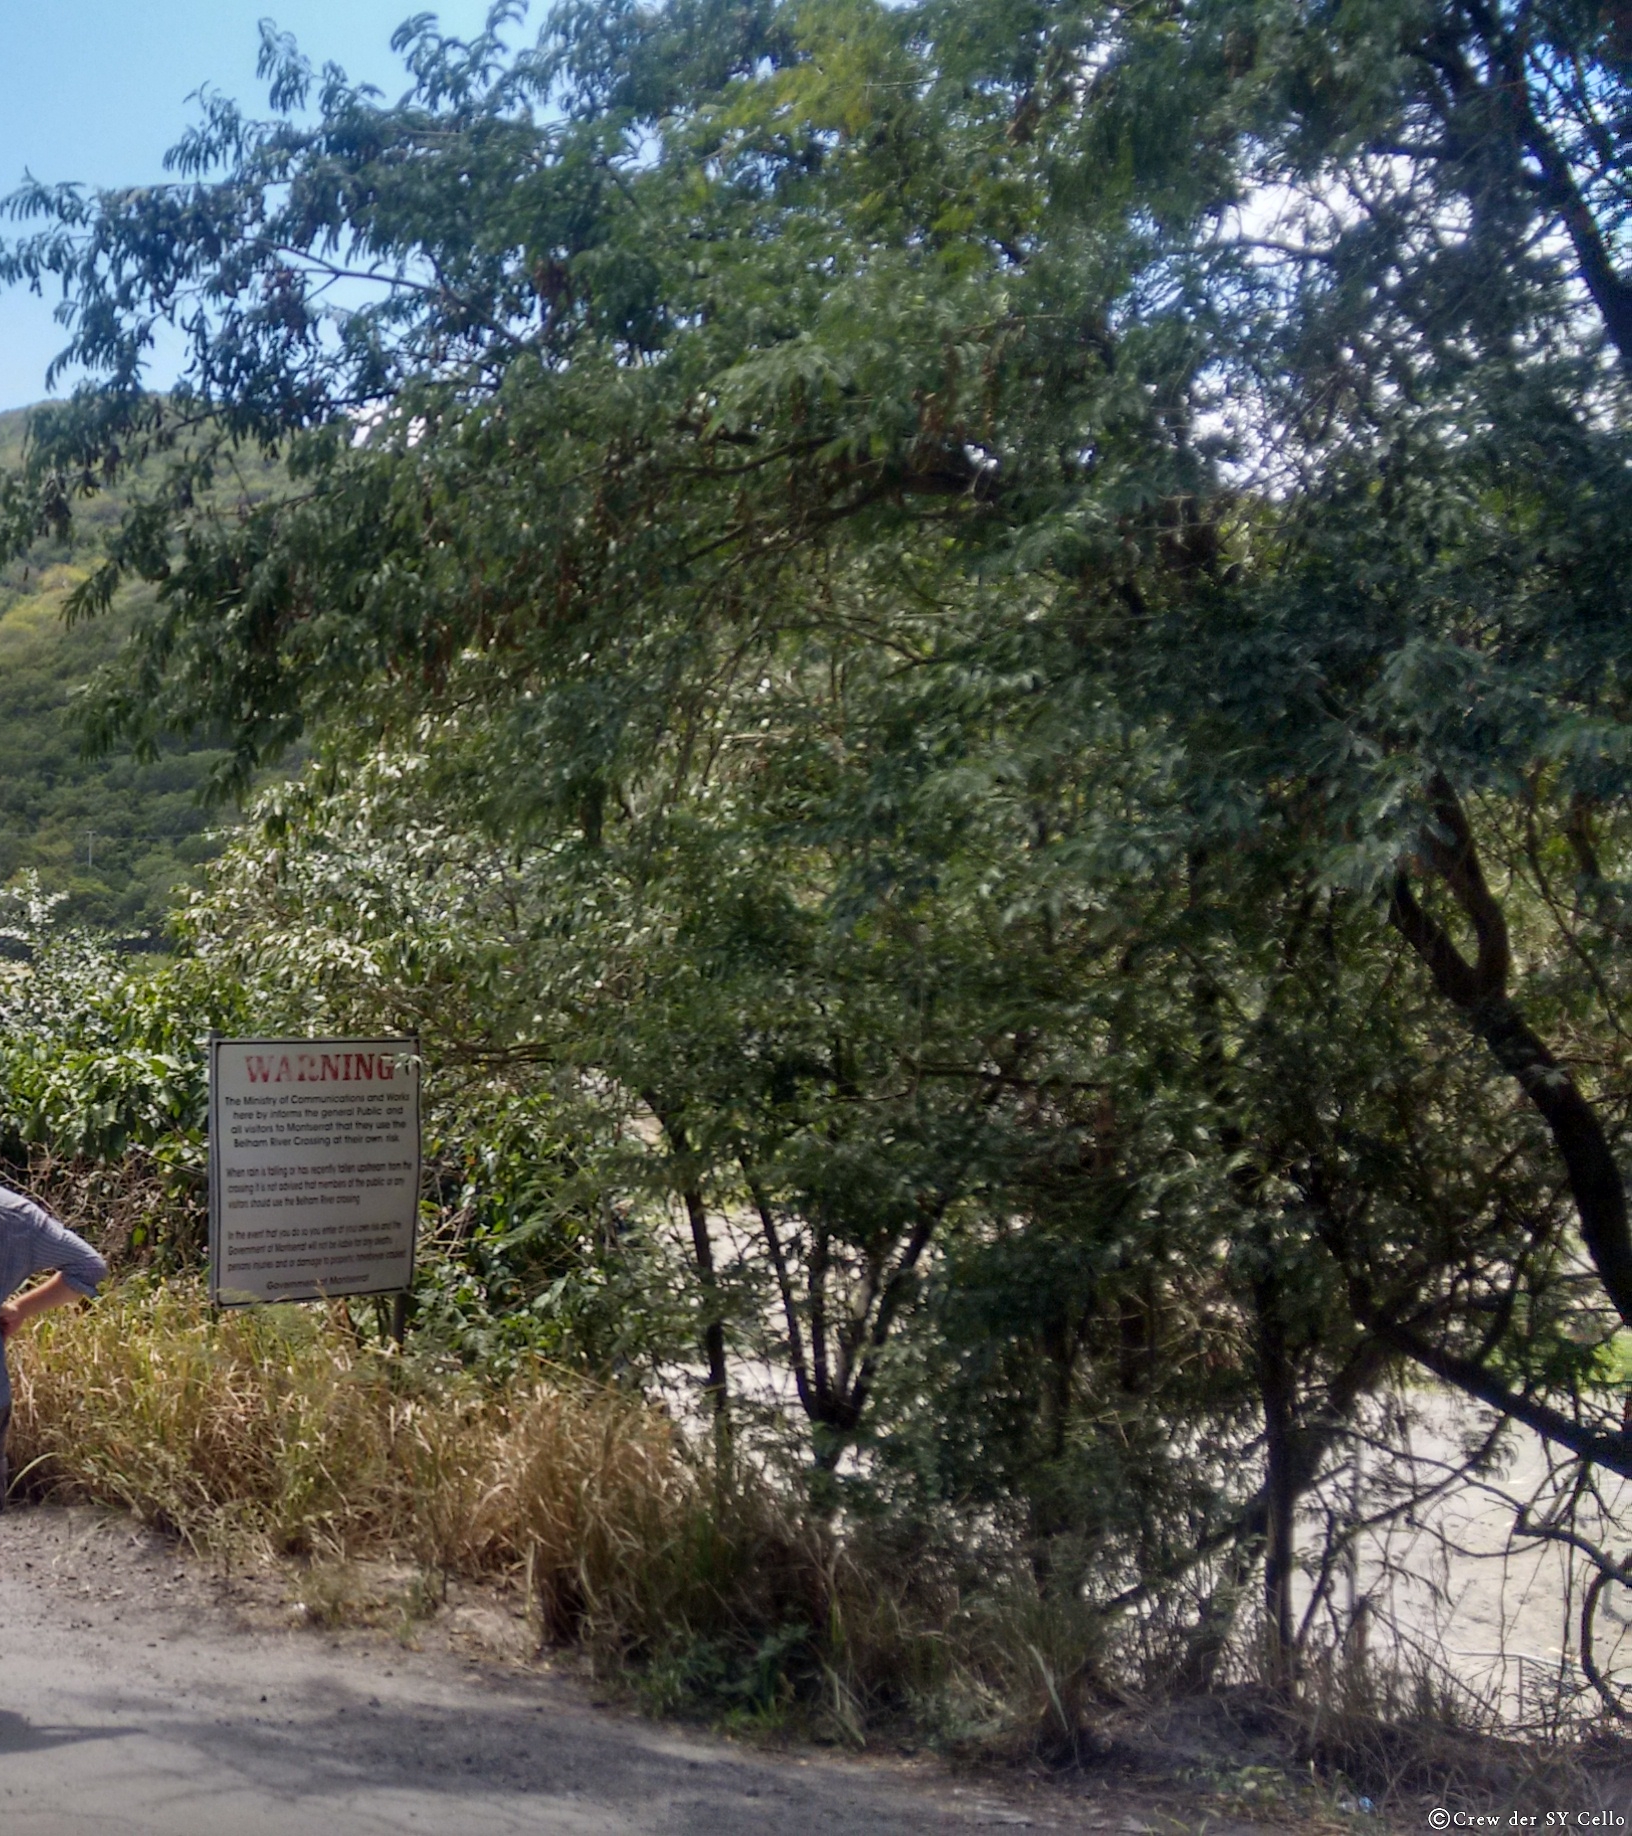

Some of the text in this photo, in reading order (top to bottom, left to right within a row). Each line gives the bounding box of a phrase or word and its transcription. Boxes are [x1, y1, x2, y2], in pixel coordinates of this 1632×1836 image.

[245, 1053, 395, 1083] WARNING
[225, 1096, 241, 1106] The
[243, 1096, 278, 1106] Ministry
[279, 1095, 289, 1104] of
[291, 1094, 365, 1104] Communications
[386, 1093, 410, 1102] Works
[233, 1106, 404, 1120] here by informs the general Public and
[231, 1120, 407, 1134] all visitors to Montserrat that they use the
[234, 1133, 399, 1148] Belham River Crossing at their own risk
[227, 1167, 246, 1177] When
[311, 1164, 336, 1175] recently
[229, 1184, 254, 1195] crossing
[279, 1181, 303, 1191] advised
[318, 1180, 347, 1189] members
[366, 1177, 385, 1188] public
[250, 1198, 272, 1208] should
[321, 1195, 335, 1205] River
[336, 1195, 360, 1206] crossing
